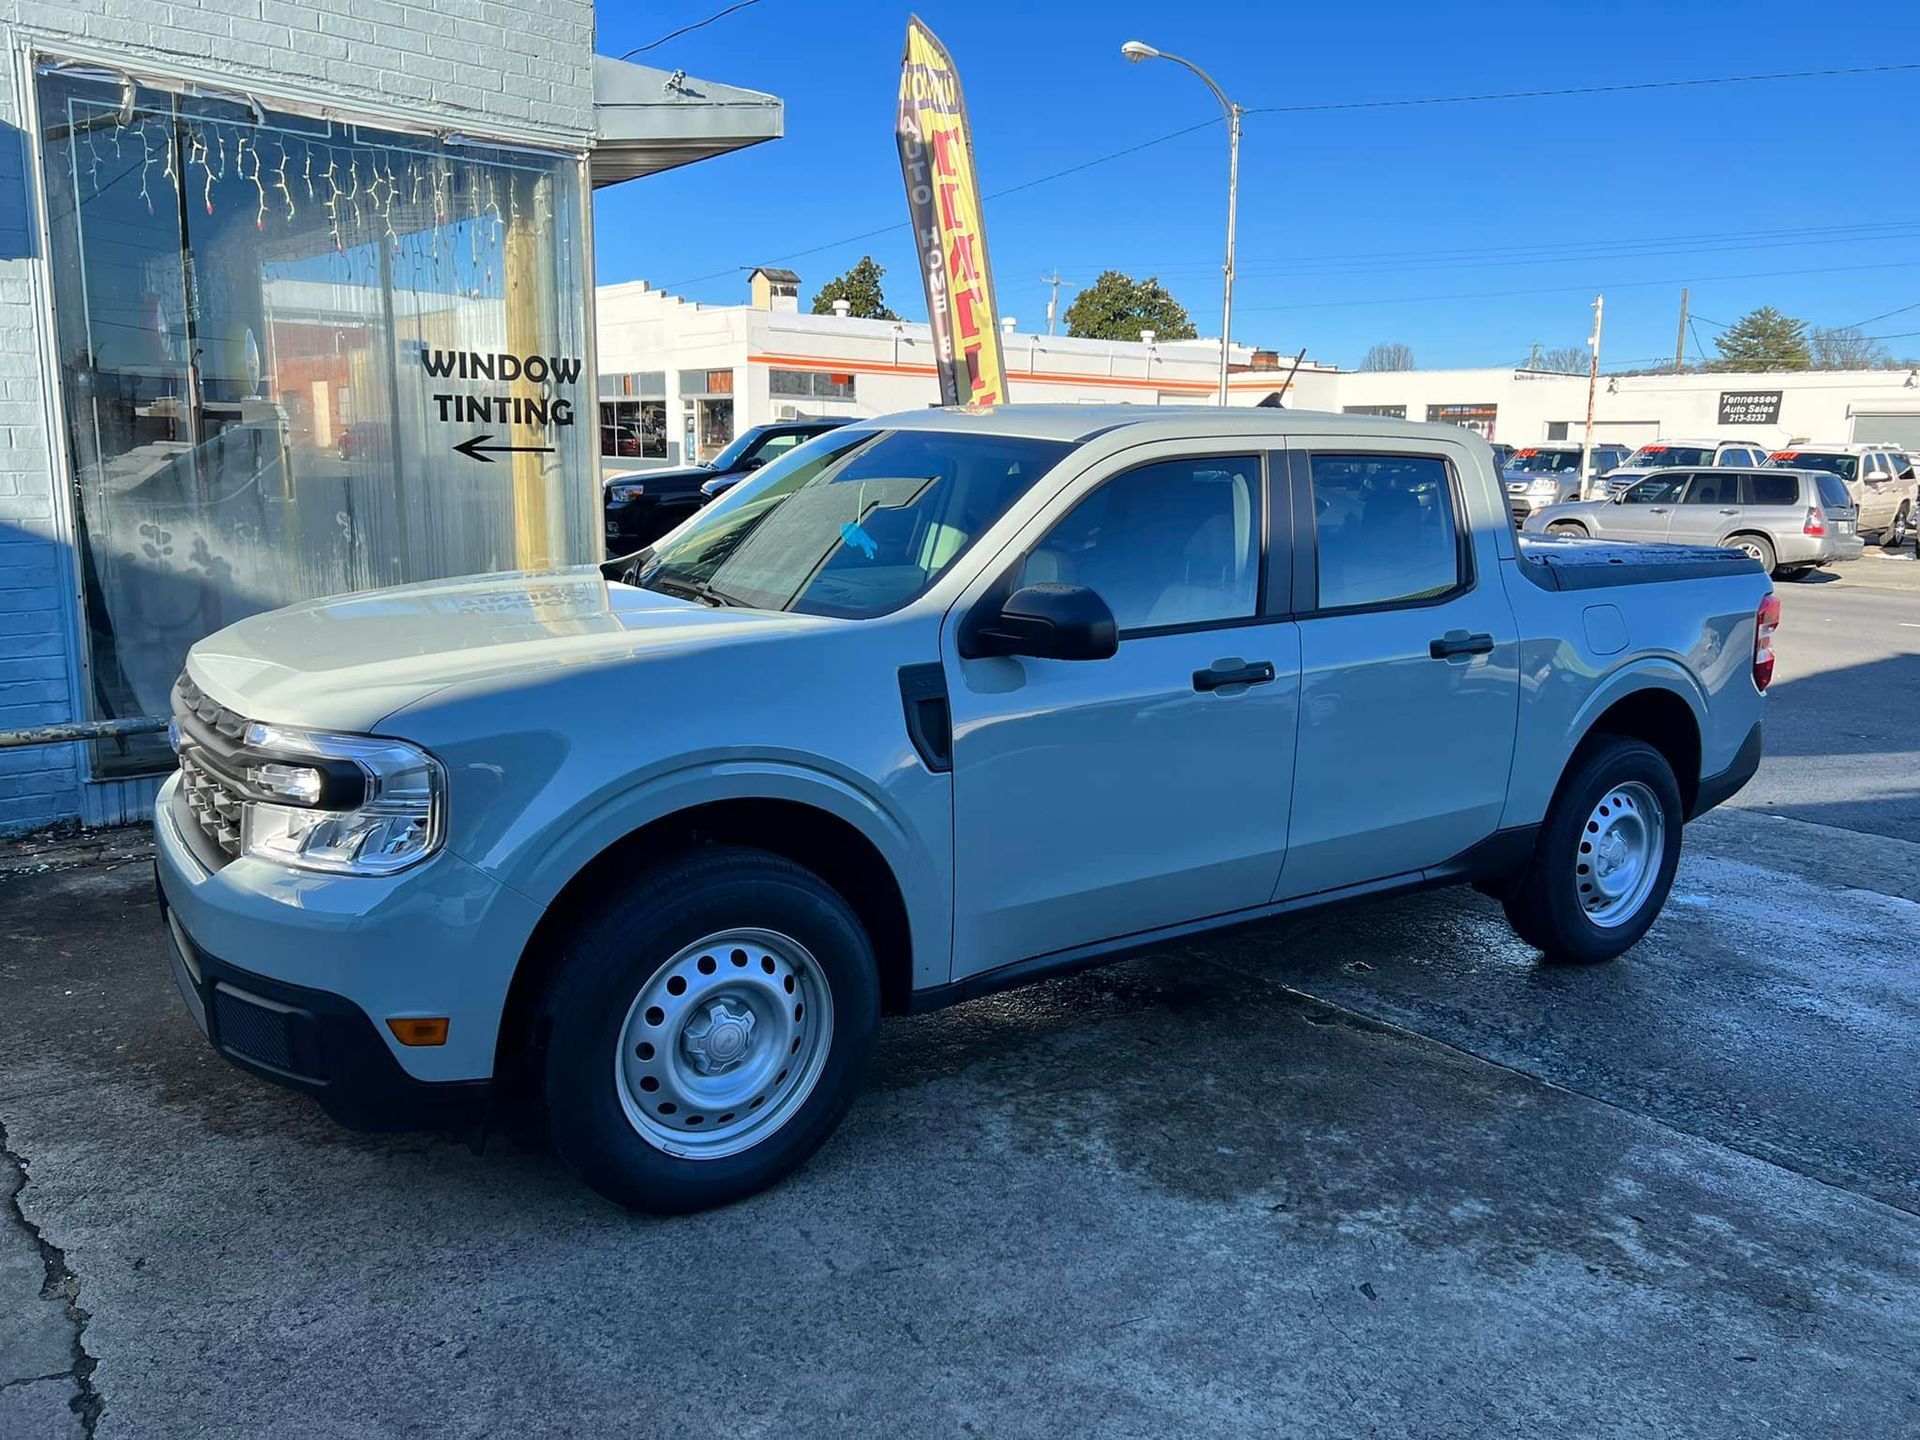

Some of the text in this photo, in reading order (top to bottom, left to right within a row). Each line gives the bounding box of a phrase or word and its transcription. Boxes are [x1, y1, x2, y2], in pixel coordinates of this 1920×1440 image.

[901, 115, 932, 205] AUTO
[920, 225, 947, 314] HOME
[421, 349, 581, 385] WINDOW
[1722, 395, 1778, 404] Tennessee
[1722, 404, 1774, 413] Auto Sales
[433, 394, 574, 426] TINTING
[1728, 413, 1767, 422] 213-5233
